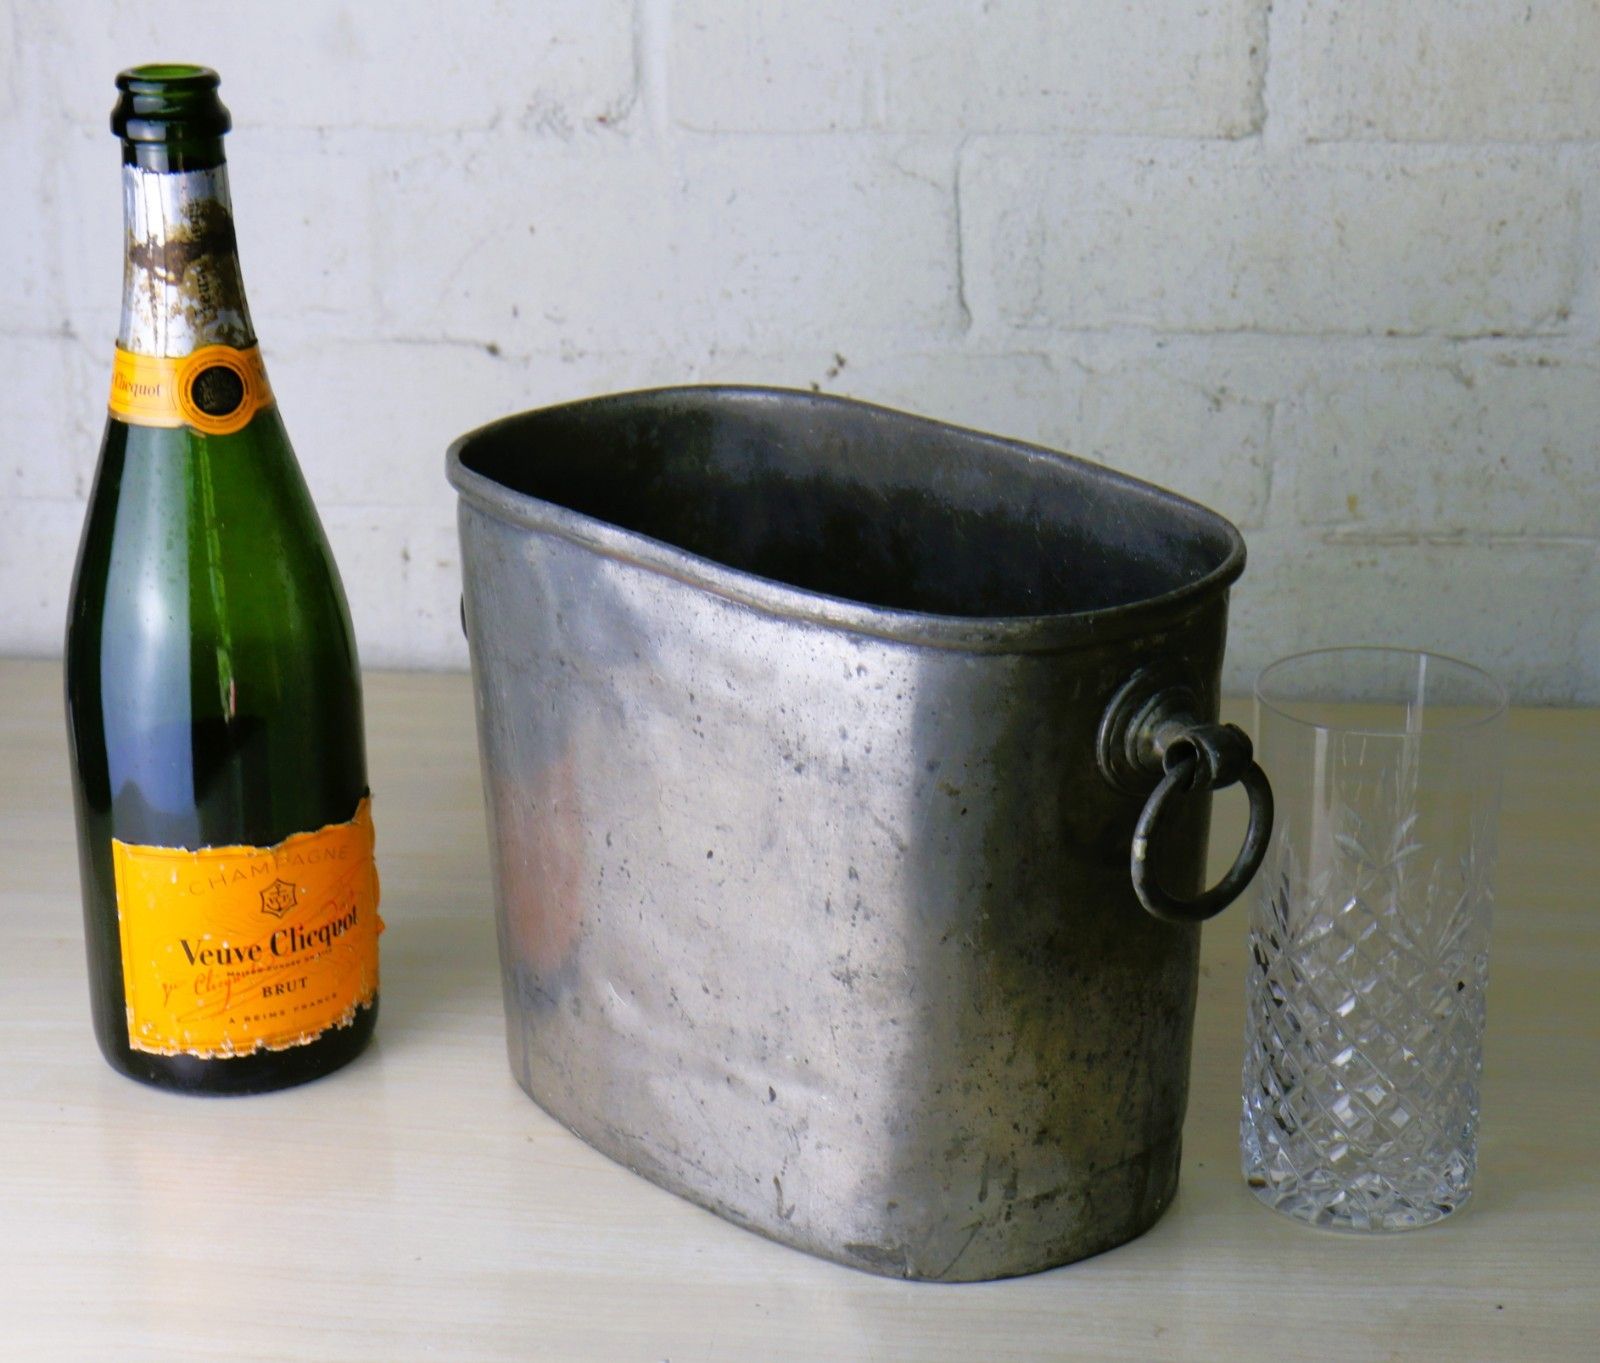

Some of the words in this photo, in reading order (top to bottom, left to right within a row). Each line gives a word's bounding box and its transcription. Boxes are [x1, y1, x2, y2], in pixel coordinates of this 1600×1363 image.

[189, 845, 349, 896] CHAMPAGNE
[180, 939, 262, 967] Veuve
[270, 905, 359, 957] Clicquot
[262, 976, 309, 998] BRUT
[294, 992, 338, 1013] FRANCE
